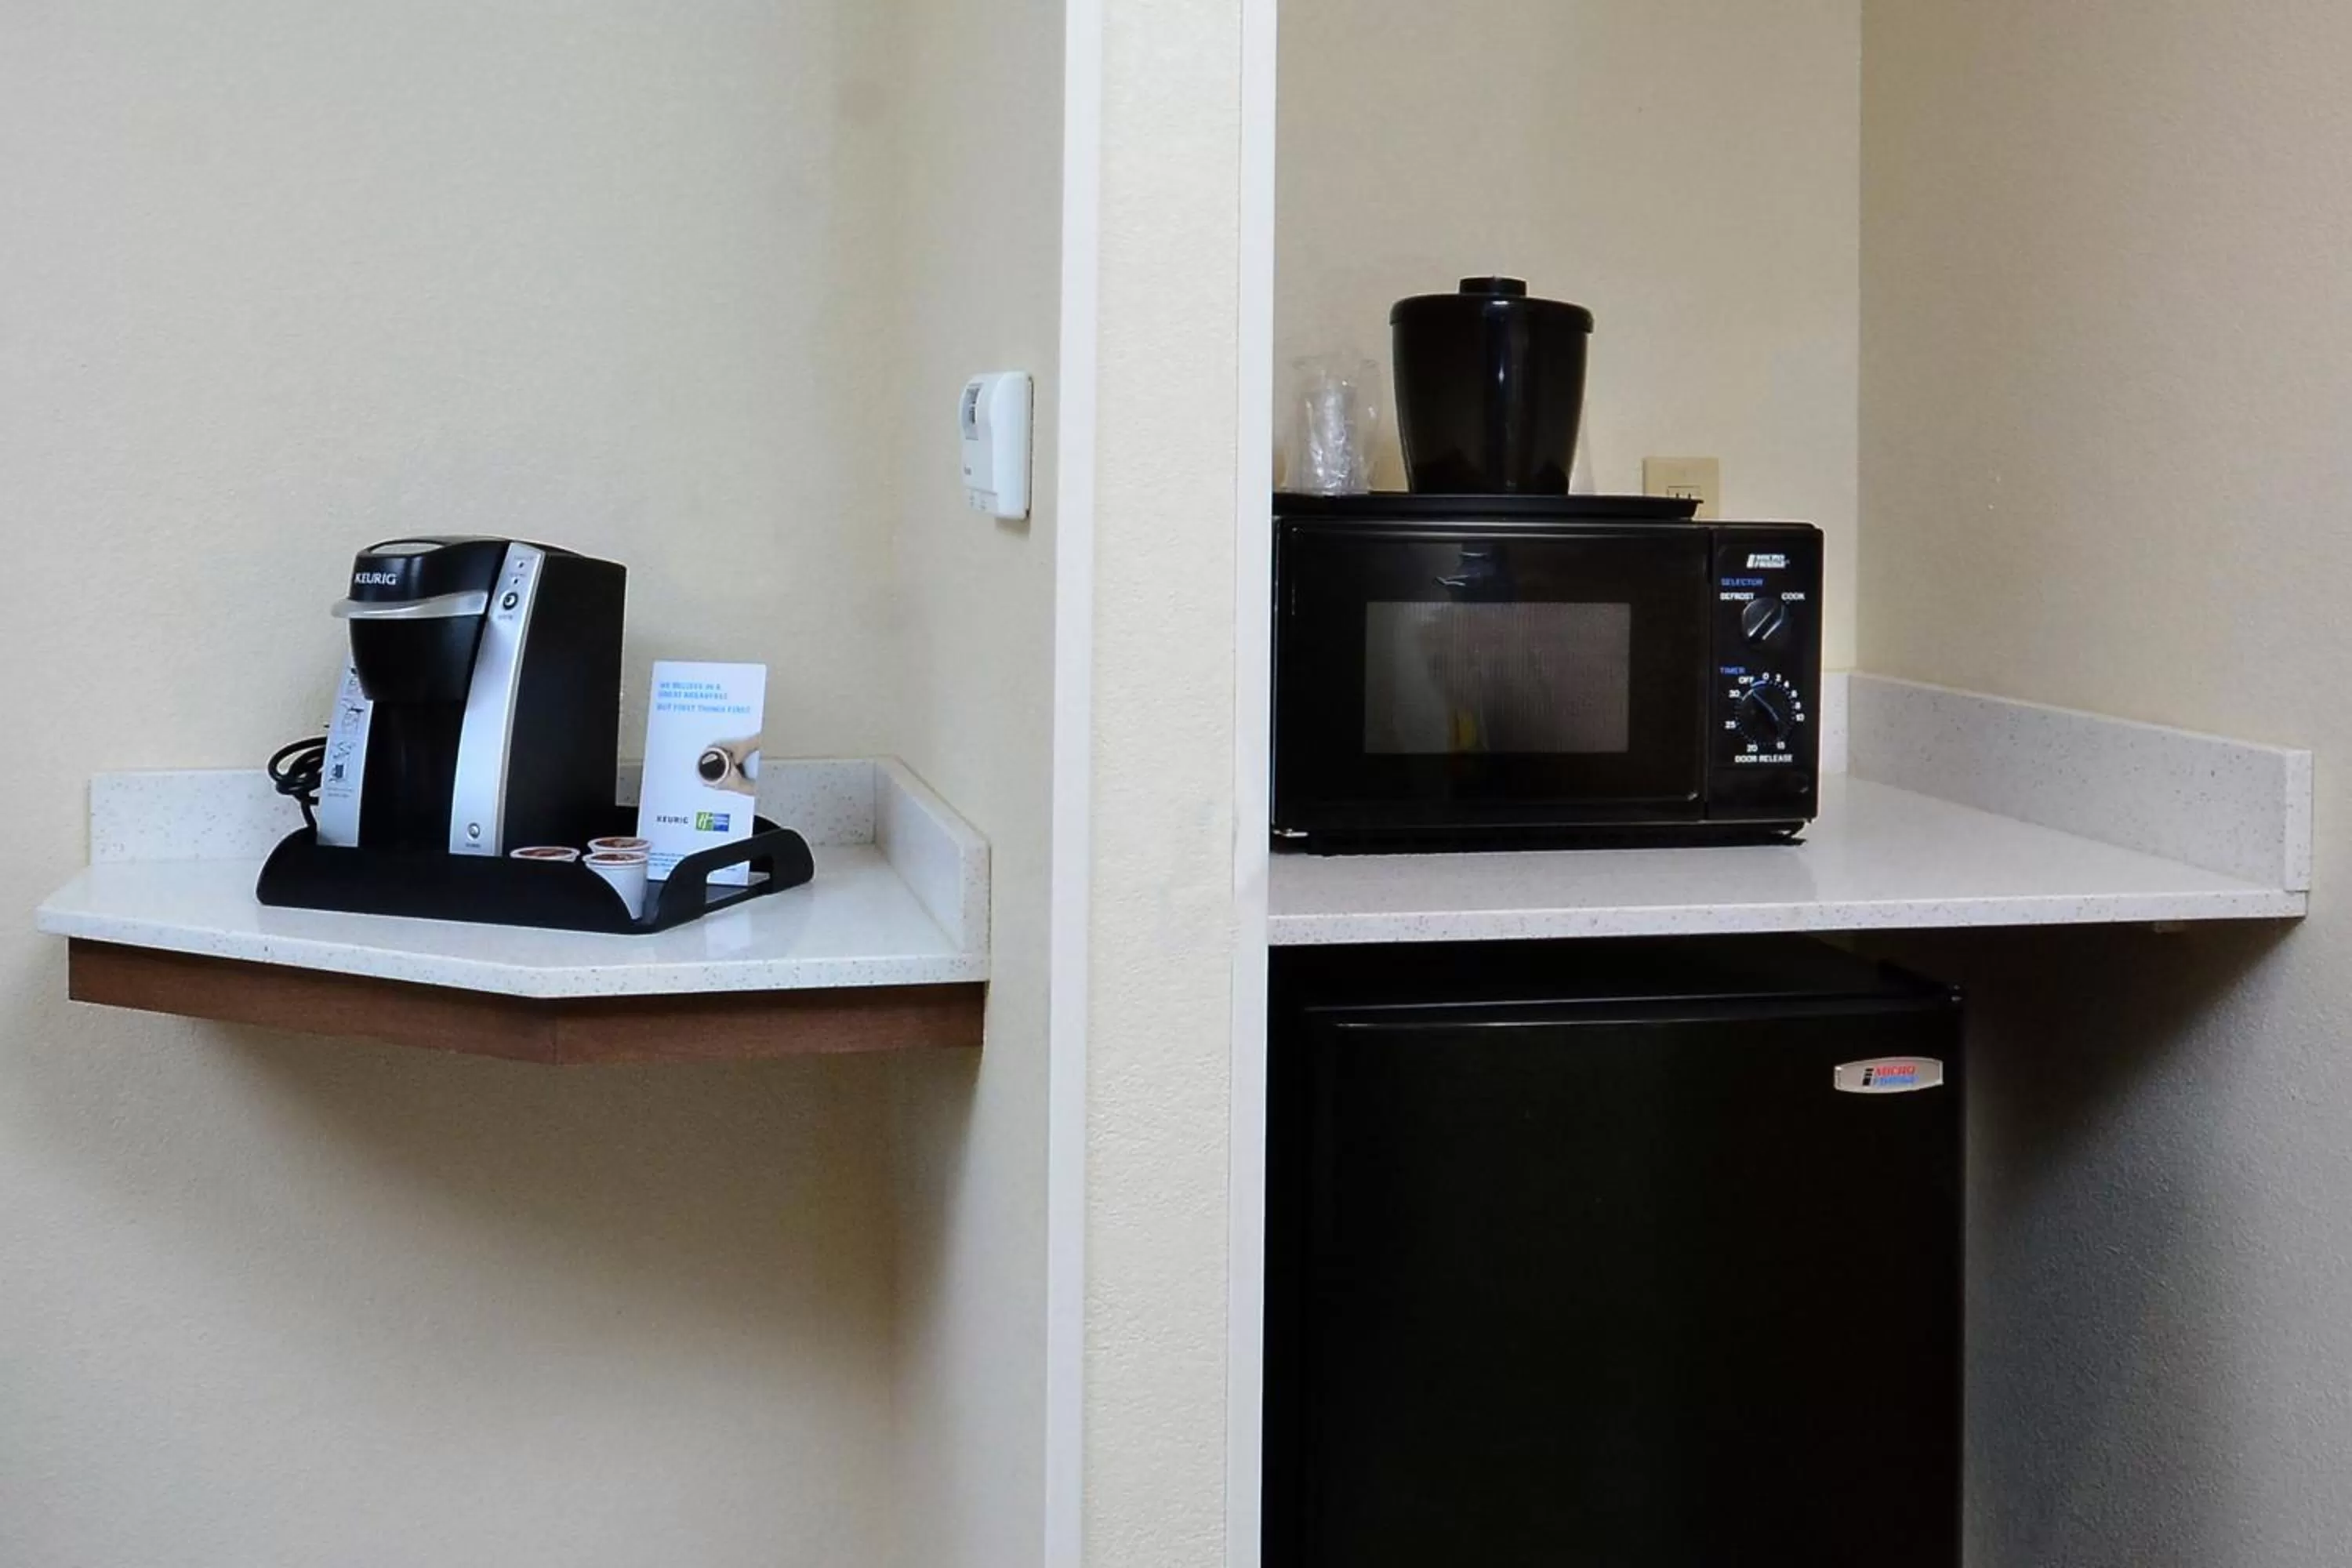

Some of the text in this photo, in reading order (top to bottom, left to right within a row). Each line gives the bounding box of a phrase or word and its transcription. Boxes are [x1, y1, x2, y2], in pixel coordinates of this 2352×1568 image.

[354, 572, 396, 585] KEURIG
[1721, 578, 1763, 586] SELECTOR
[1759, 754, 1793, 763] RELEASE
[656, 815, 689, 824] KEURIG
